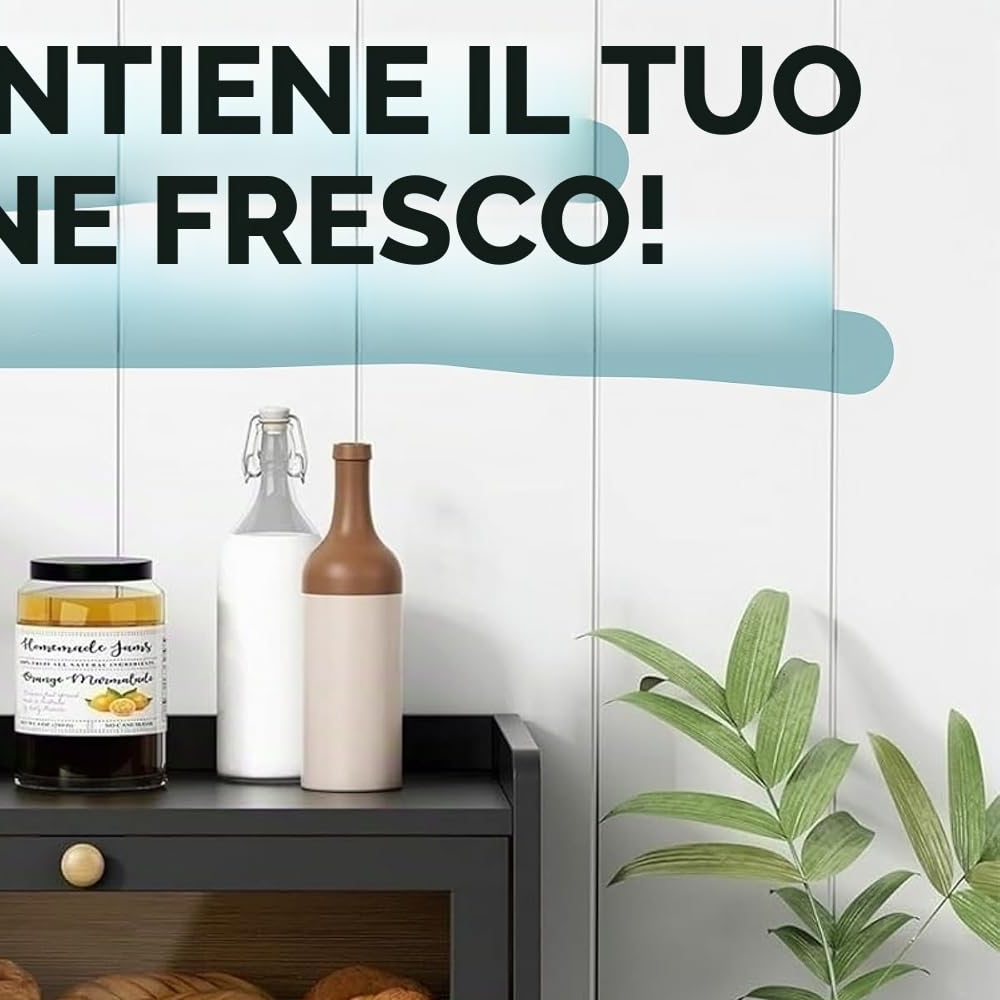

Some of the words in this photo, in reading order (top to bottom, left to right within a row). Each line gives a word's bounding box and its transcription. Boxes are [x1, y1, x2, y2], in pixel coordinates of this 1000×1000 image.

[20, 637, 107, 654] Homemade
[110, 639, 152, 657] Jams
[23, 671, 64, 688] Orange
